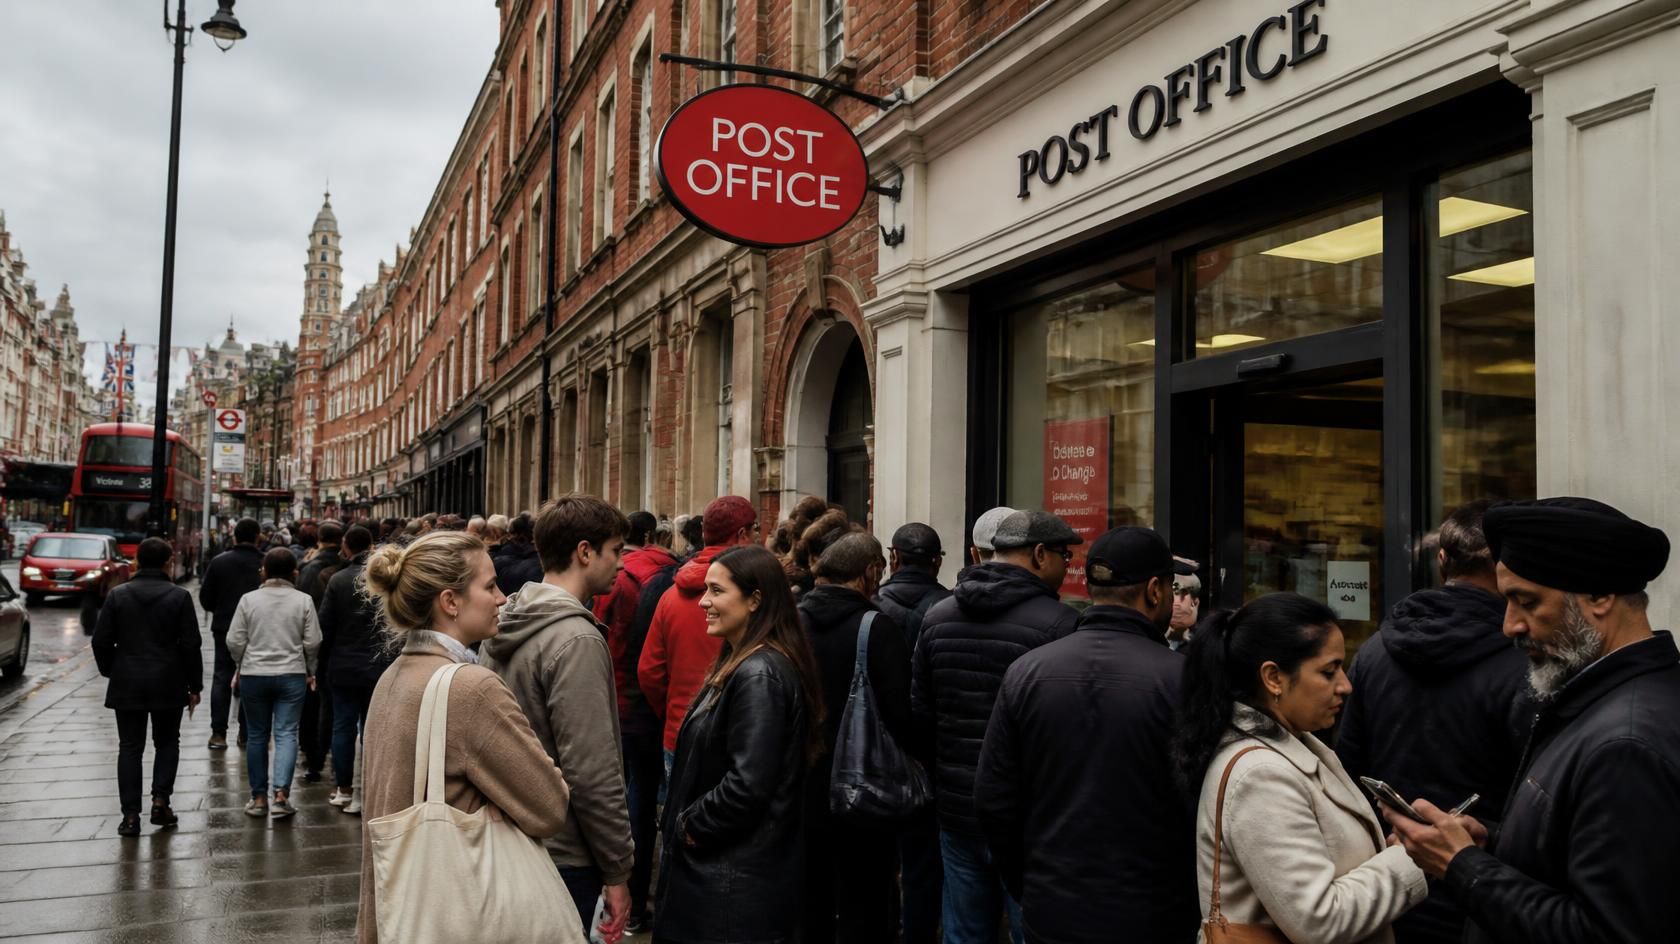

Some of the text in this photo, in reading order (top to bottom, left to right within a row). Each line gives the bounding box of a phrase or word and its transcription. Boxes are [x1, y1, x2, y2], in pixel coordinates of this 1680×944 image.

[1016, 0, 1329, 199] POST OFFICE
[712, 117, 824, 164] POST
[686, 158, 841, 210] OFFICE
